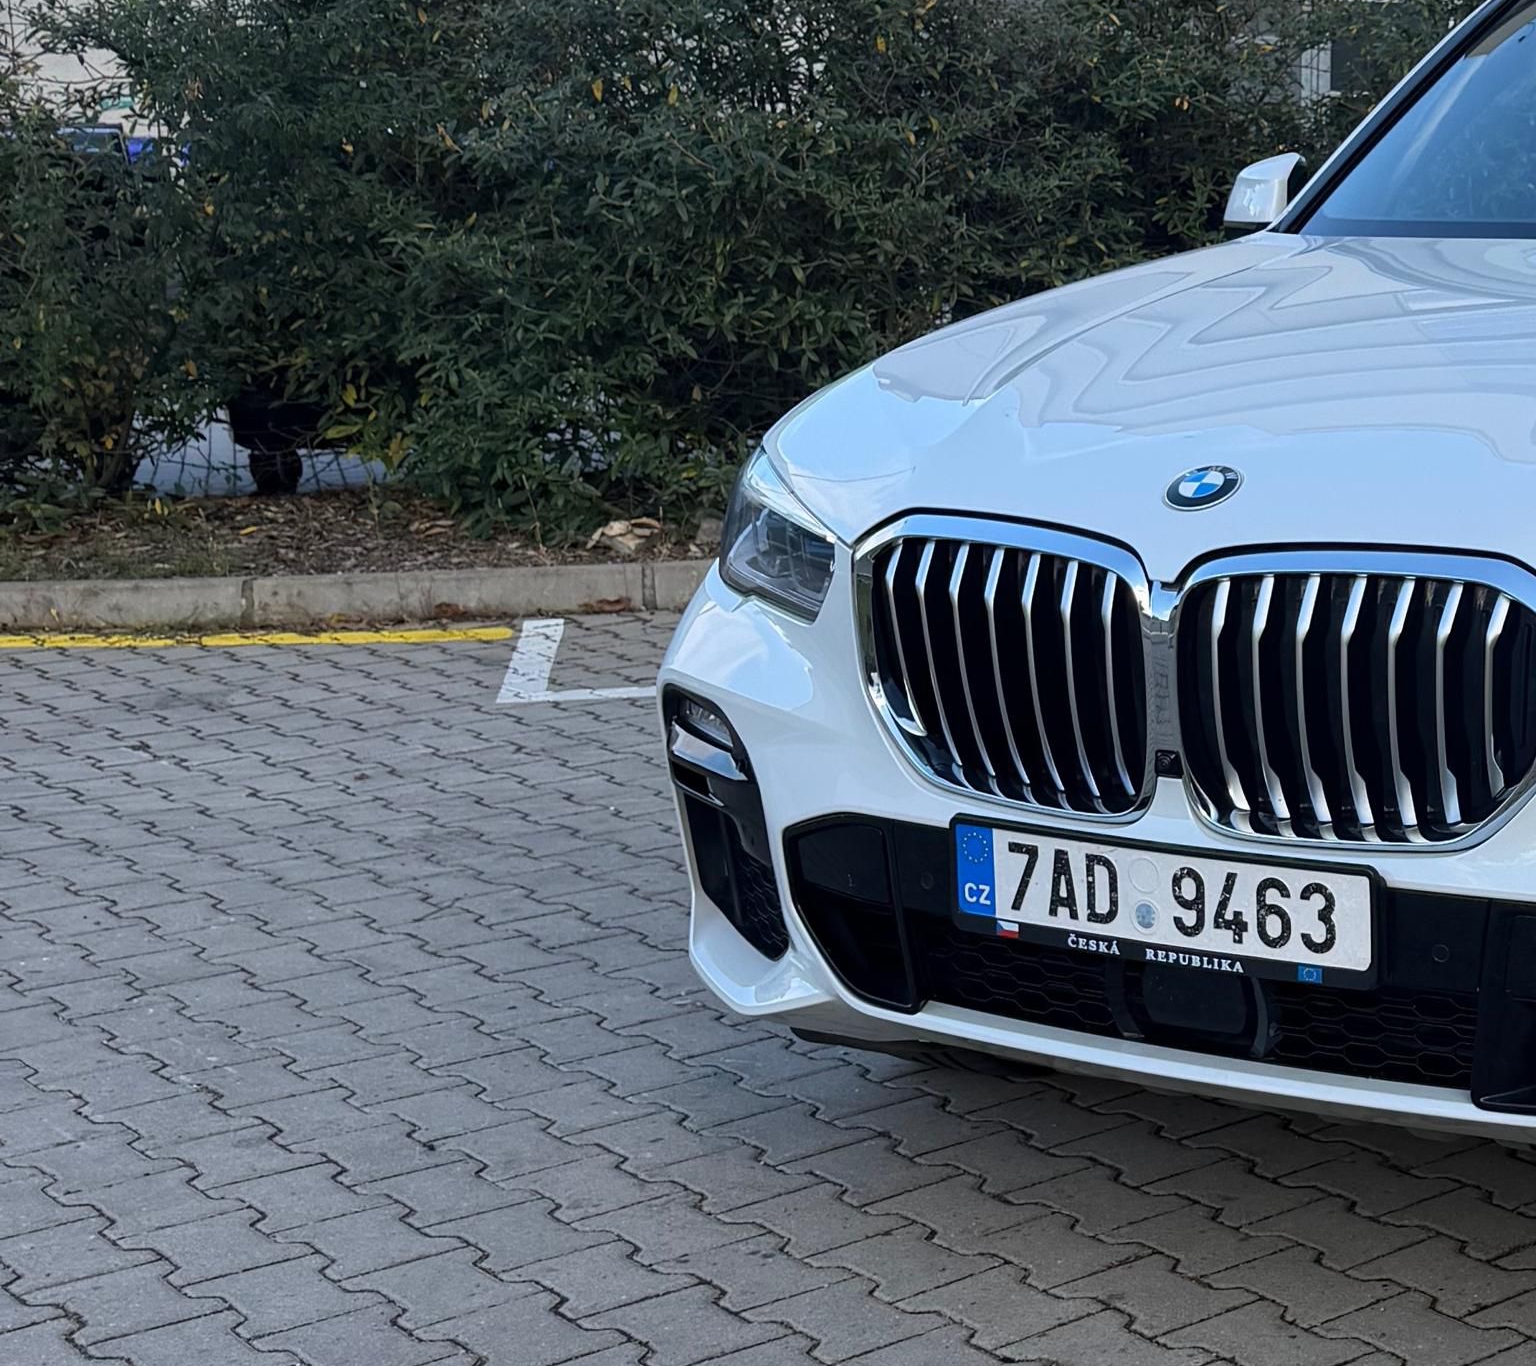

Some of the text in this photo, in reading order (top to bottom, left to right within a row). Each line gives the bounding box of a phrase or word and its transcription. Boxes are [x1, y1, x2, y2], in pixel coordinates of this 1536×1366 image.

[964, 882, 991, 906] CZ
[1008, 841, 1337, 955] 7AD 9463
[1067, 933, 1245, 974] ČESKÁ REPUBLIKA
